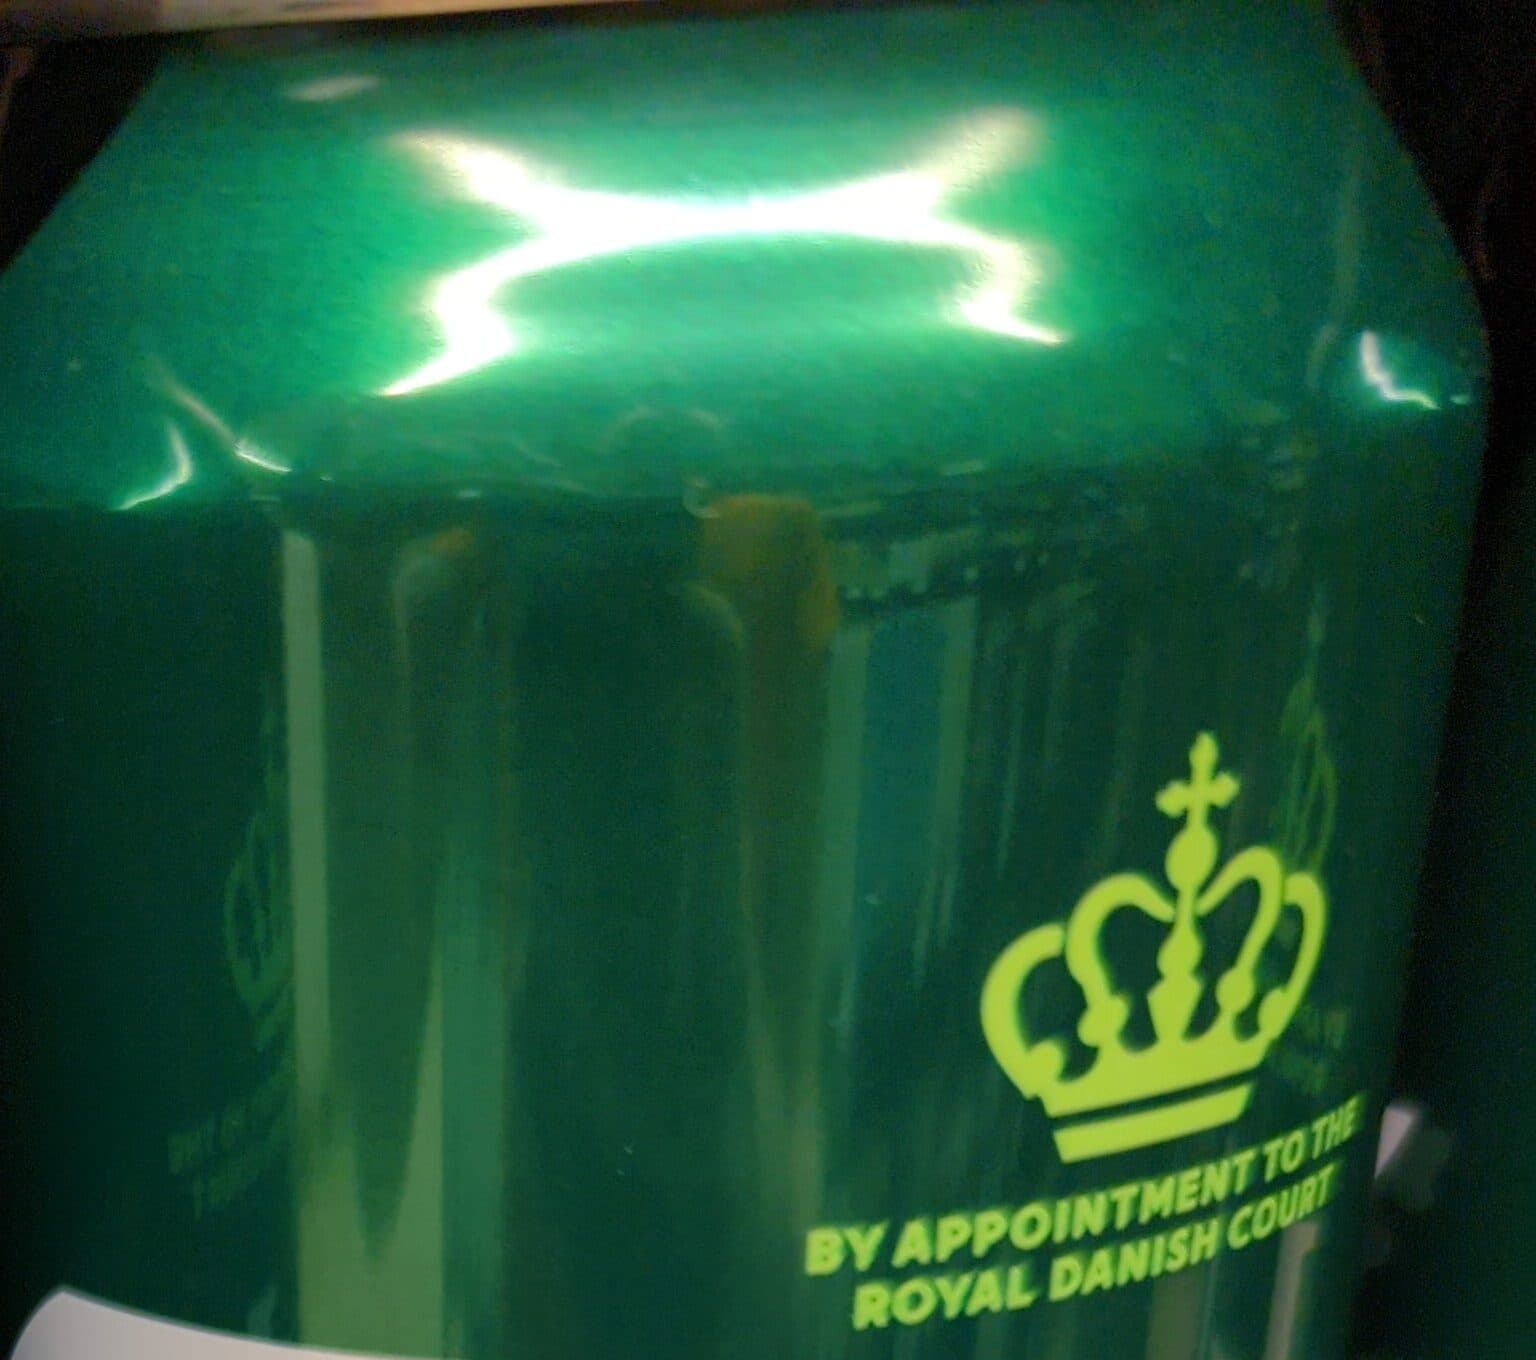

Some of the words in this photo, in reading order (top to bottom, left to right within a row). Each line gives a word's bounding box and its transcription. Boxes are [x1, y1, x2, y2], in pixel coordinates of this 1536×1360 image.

[805, 1221, 887, 1275] BY
[891, 1150, 1257, 1268] APPOINTMENT
[1263, 1137, 1303, 1187] TO
[1311, 1090, 1362, 1162] THE
[853, 1262, 1036, 1330] ROYAL
[1048, 1217, 1220, 1301] DANISH
[1228, 1160, 1341, 1249] COURT
